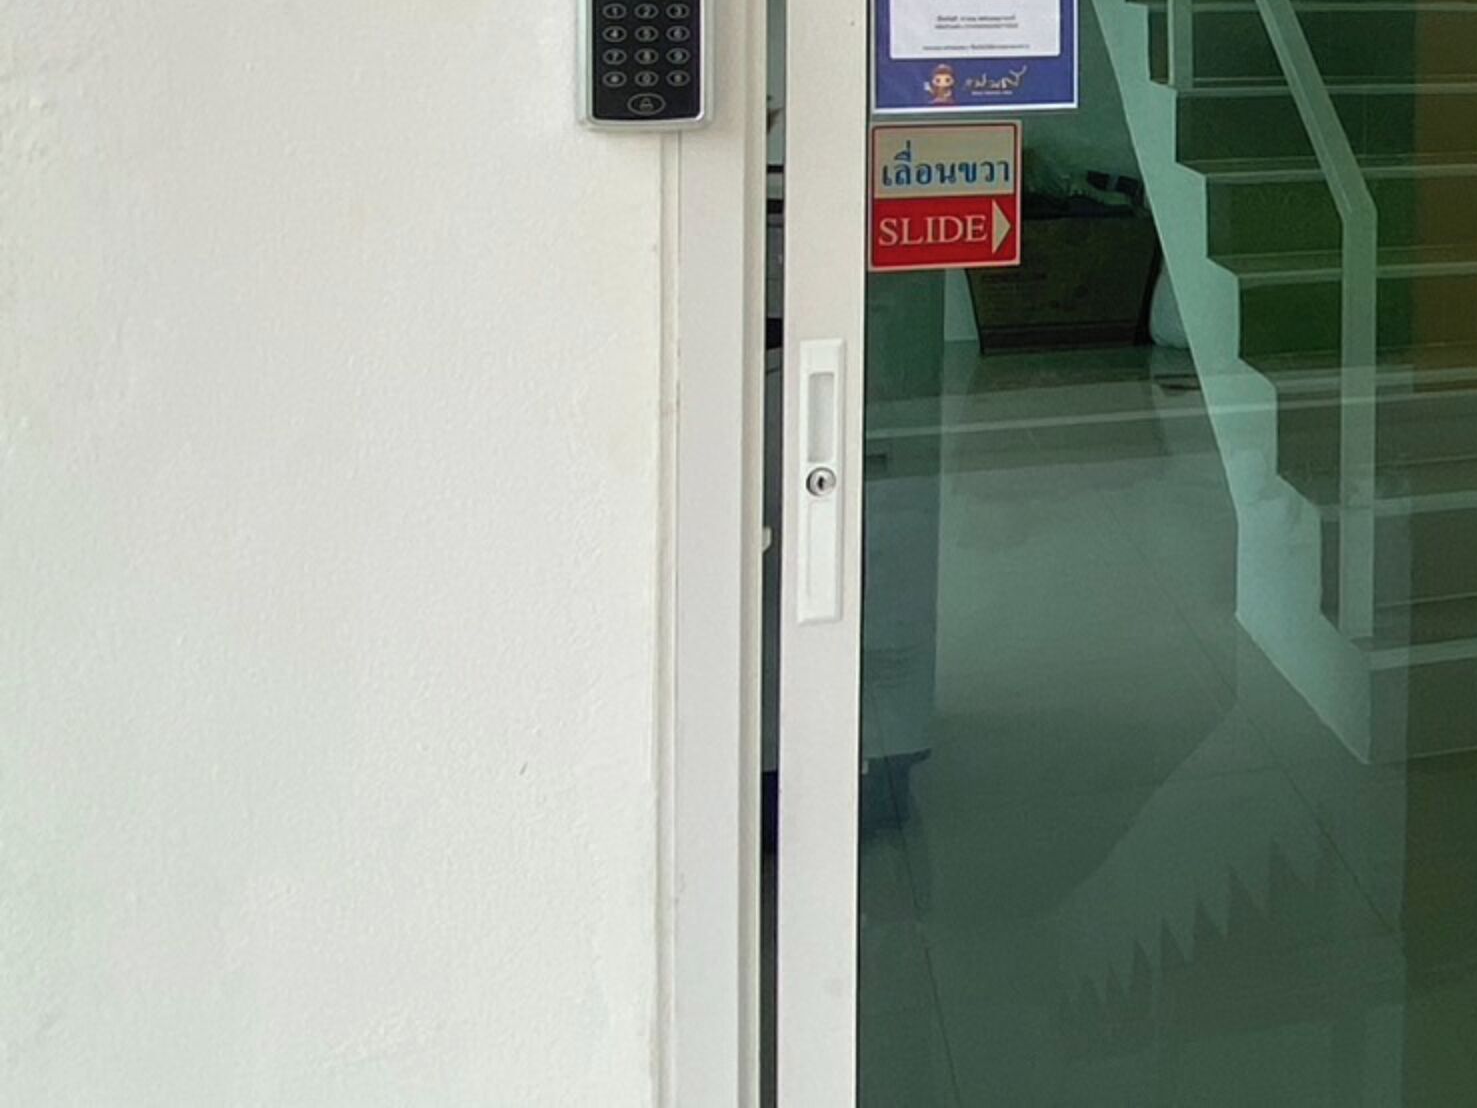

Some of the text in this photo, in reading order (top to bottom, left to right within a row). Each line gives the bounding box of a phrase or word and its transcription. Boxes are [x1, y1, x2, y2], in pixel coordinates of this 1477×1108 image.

[882, 140, 1009, 186] เลื่อนขวา
[879, 215, 988, 246] SLIDE
